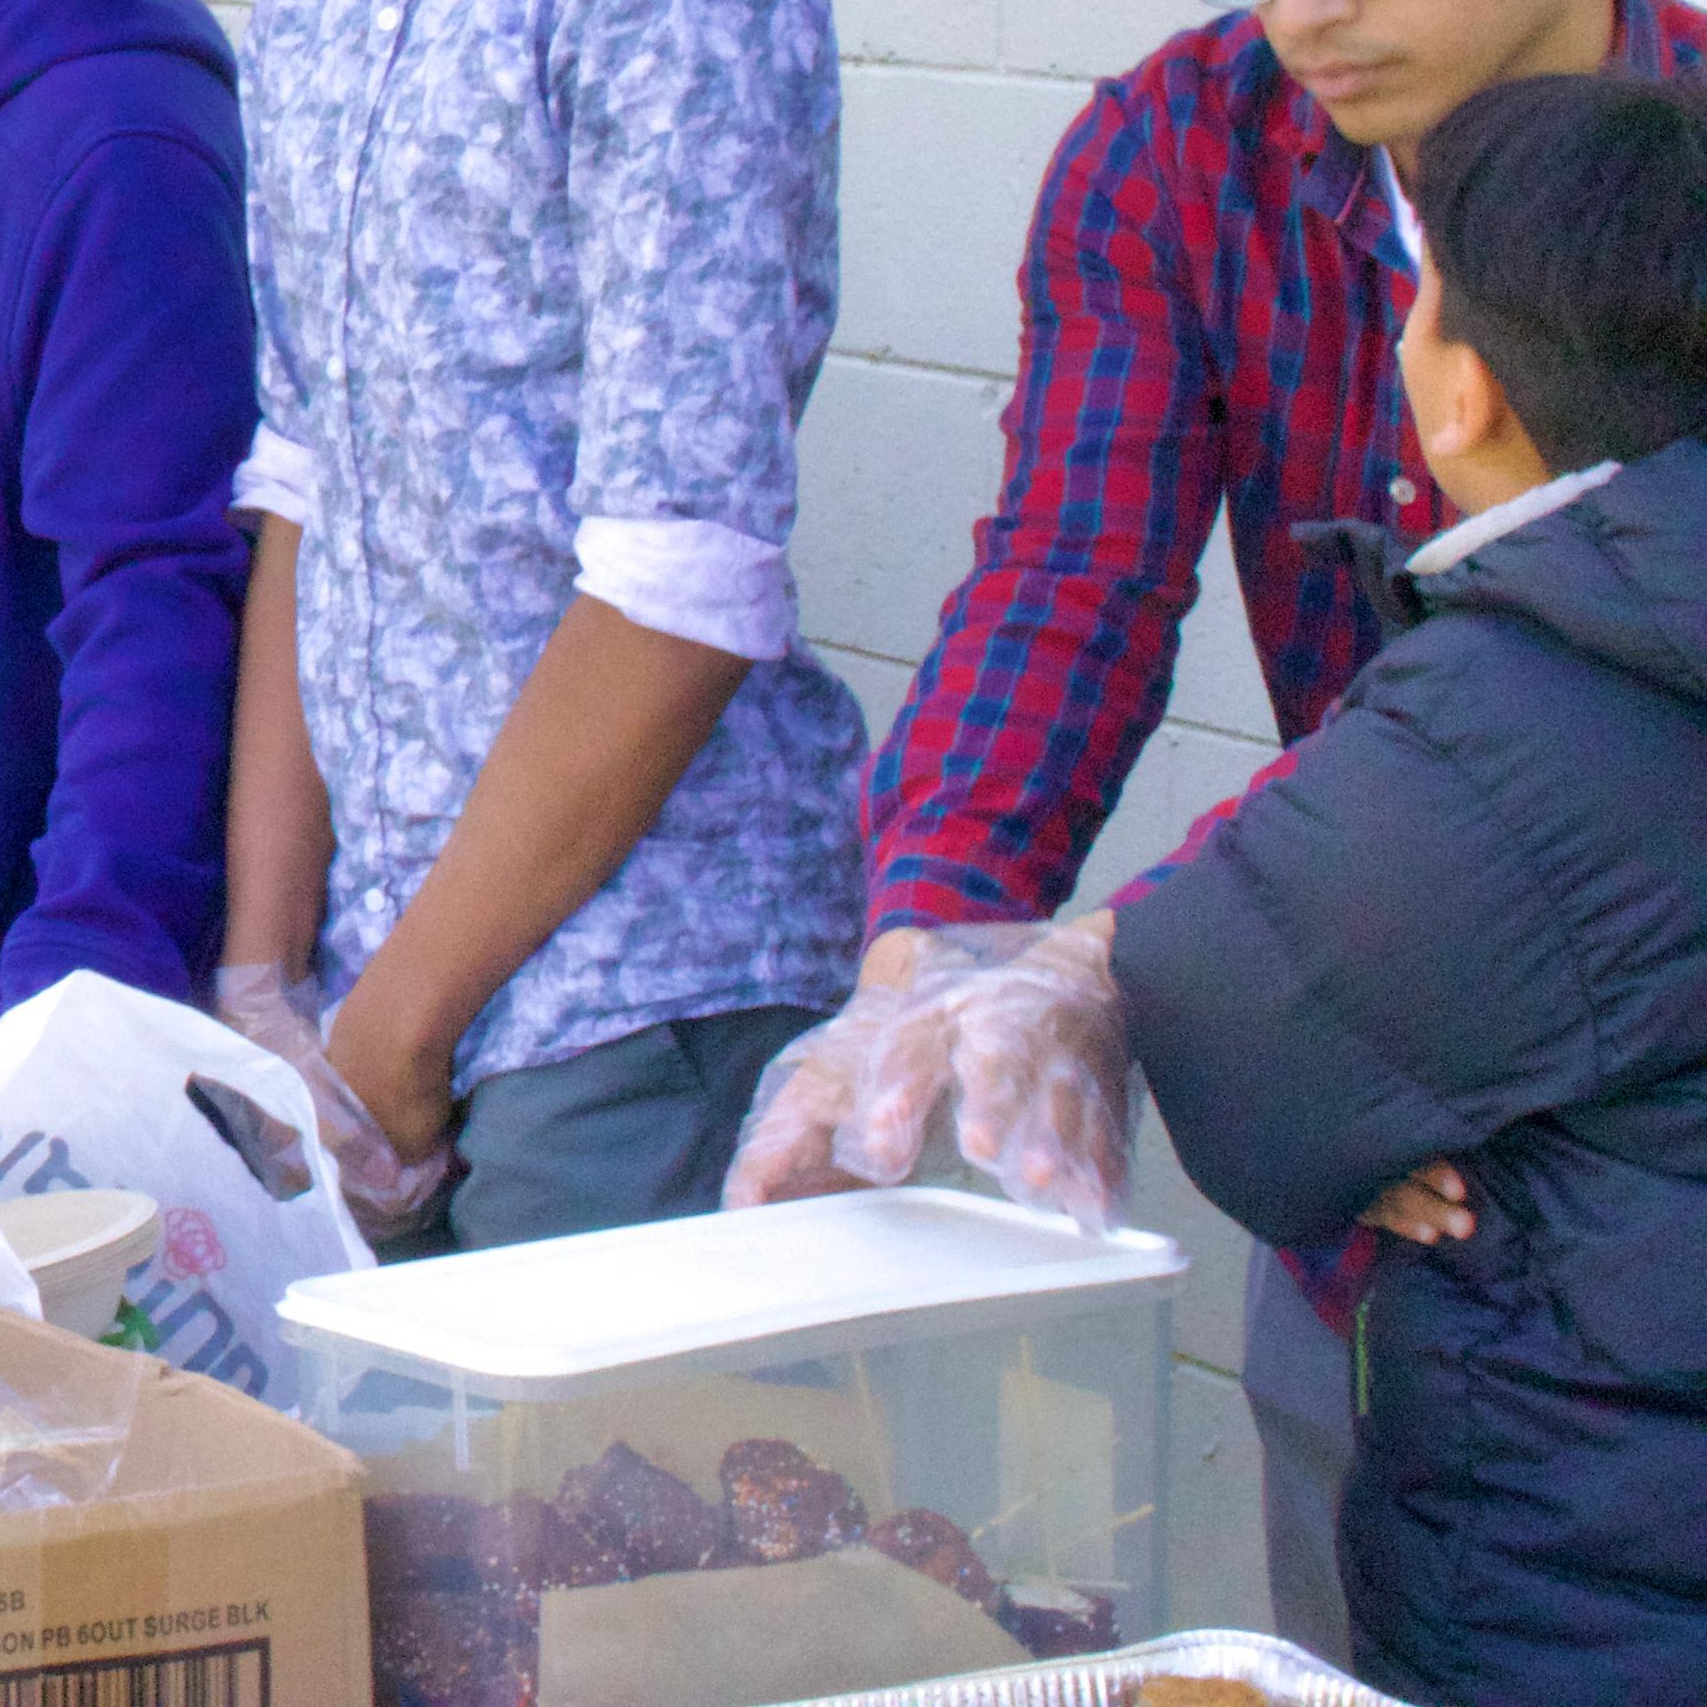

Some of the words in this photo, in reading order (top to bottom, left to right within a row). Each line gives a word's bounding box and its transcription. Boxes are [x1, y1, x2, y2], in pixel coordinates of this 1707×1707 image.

[41, 1625, 71, 1649] PB
[142, 1606, 222, 1638] SURGE
[226, 1599, 271, 1627] BLK
